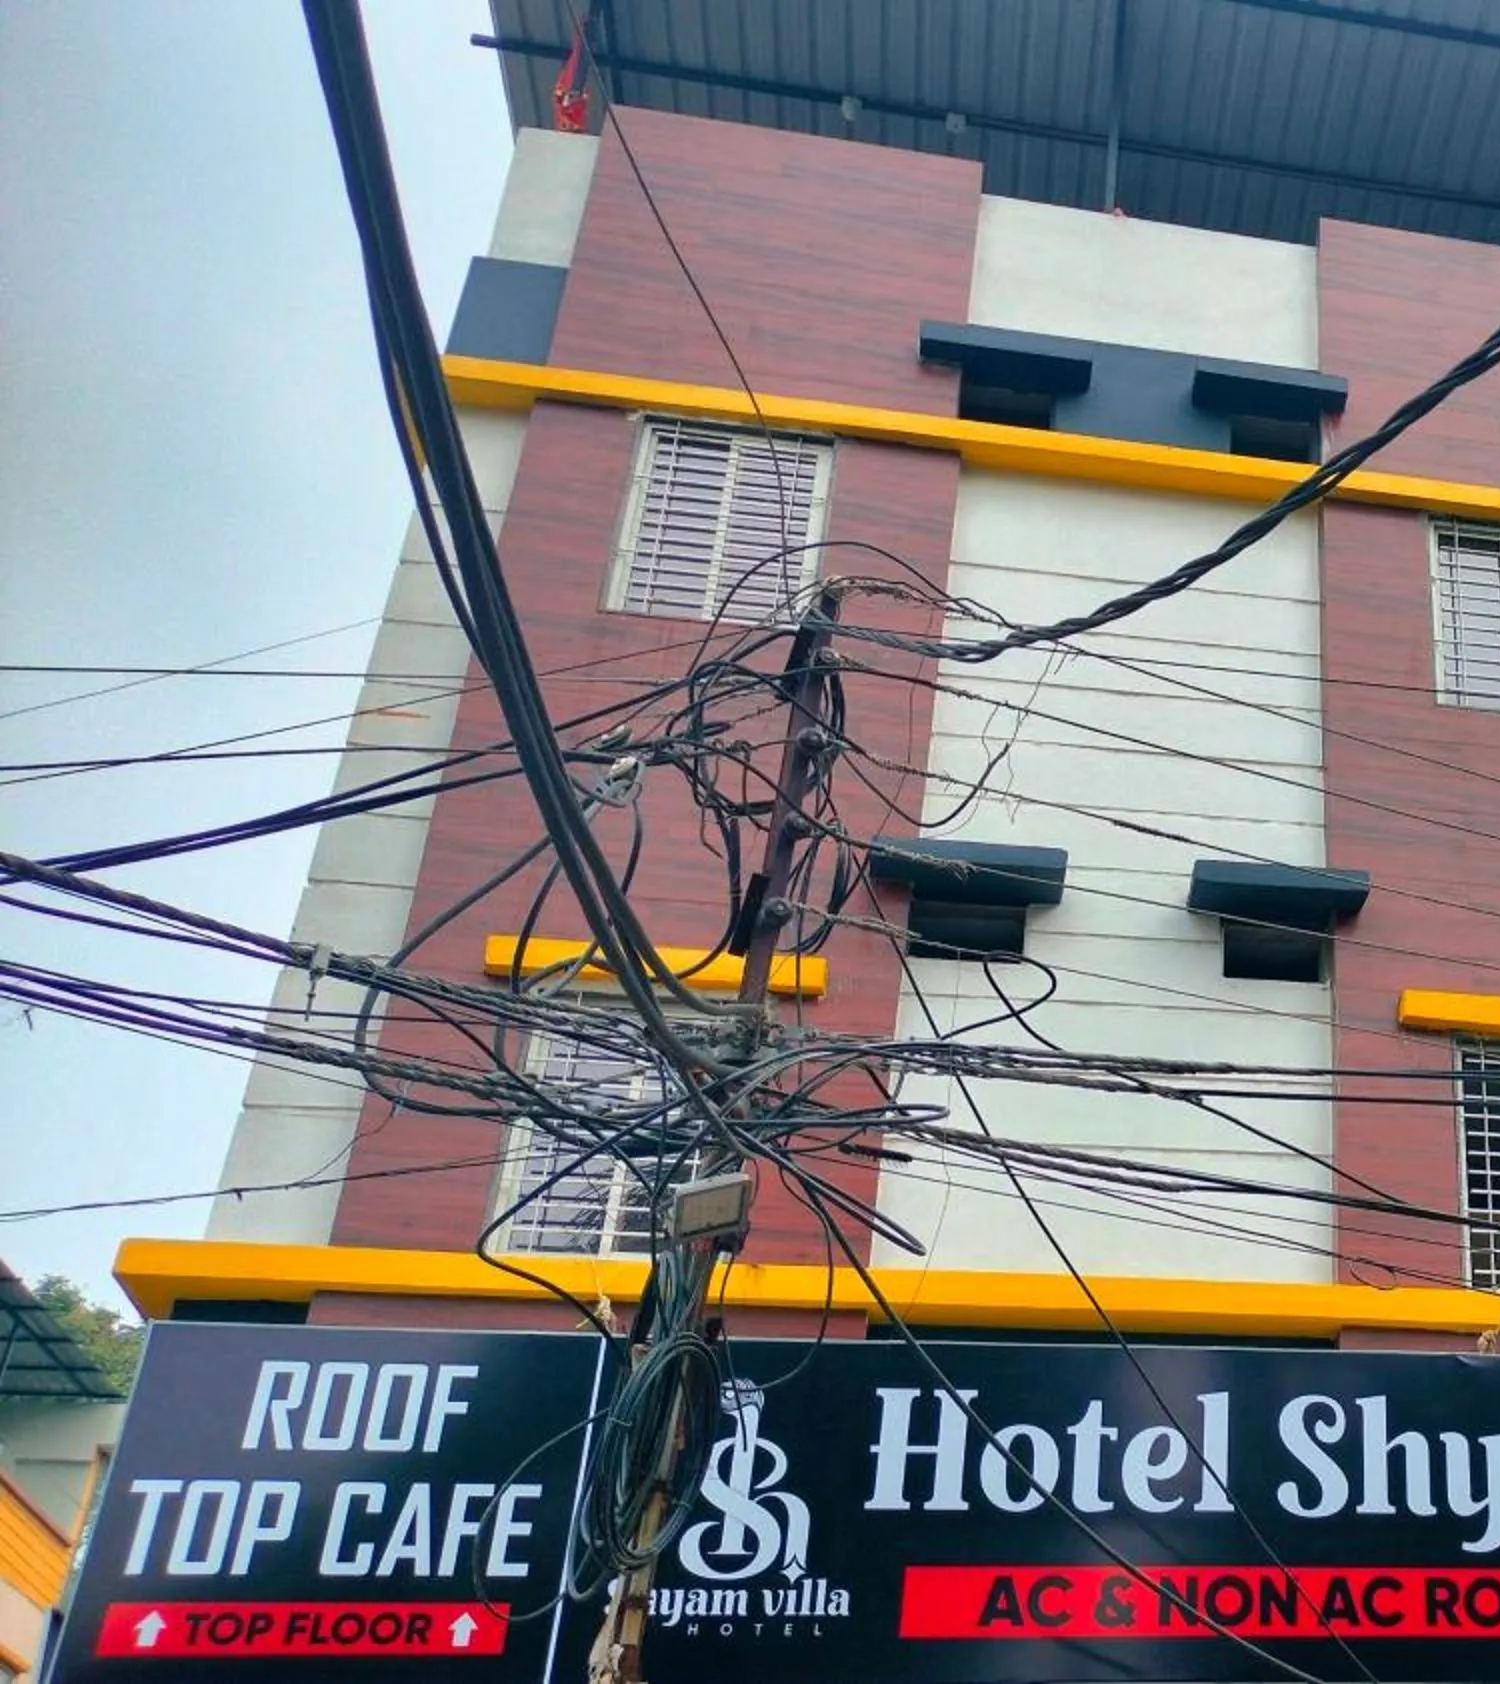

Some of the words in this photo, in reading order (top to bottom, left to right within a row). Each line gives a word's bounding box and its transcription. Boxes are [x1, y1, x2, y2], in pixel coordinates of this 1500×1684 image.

[241, 1360, 480, 1453] ROOF
[863, 1387, 1234, 1513] Hotel
[123, 1479, 301, 1576] TOP
[318, 1481, 542, 1577] CAFE
[604, 1577, 748, 1627] yam
[763, 1578, 850, 1616] villa
[976, 1575, 1076, 1627] AC
[1093, 1577, 1136, 1627] &
[1156, 1575, 1300, 1628] NON
[1316, 1576, 1405, 1627] AC
[184, 1612, 273, 1645] TOP
[283, 1613, 432, 1645] FLOOR
[687, 1623, 823, 1636] HOTEL
